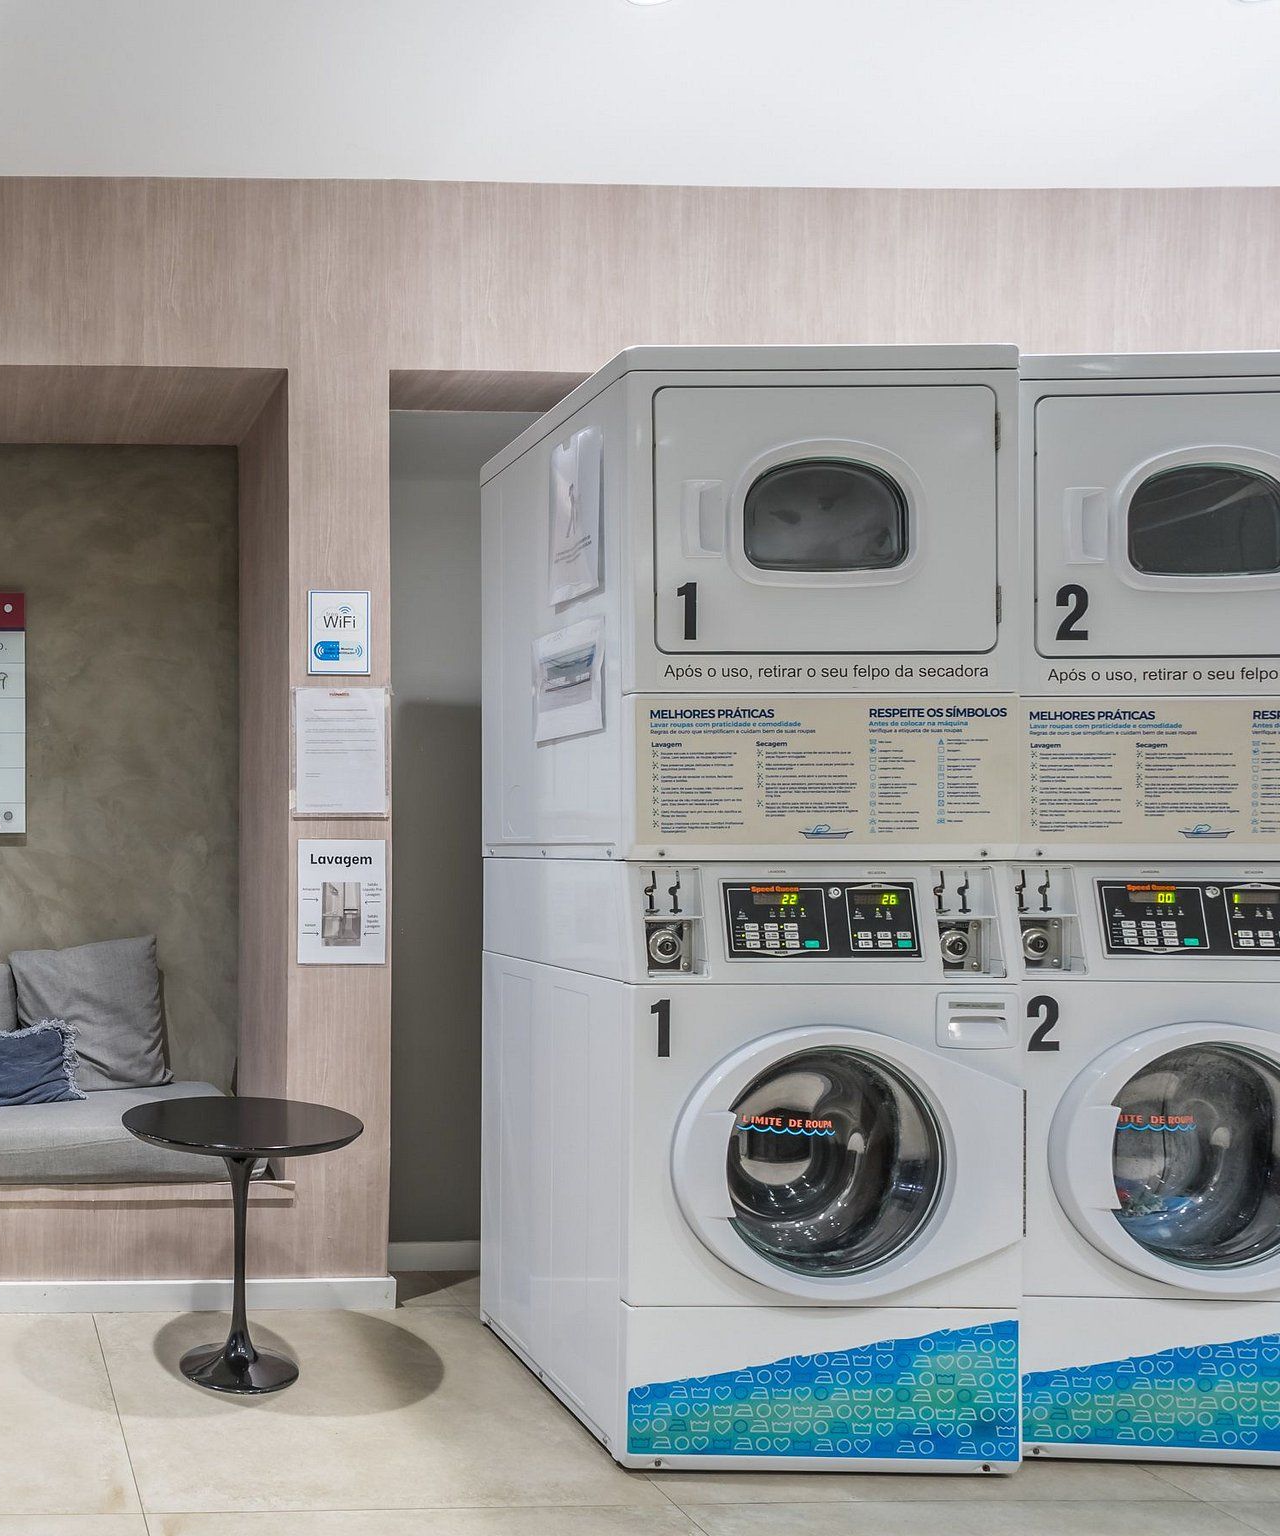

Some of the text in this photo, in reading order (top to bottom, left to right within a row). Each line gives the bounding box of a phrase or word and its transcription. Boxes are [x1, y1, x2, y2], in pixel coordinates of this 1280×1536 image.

[676, 582, 697, 640] 1
[1056, 584, 1089, 641] 2
[323, 616, 356, 628] WiFi
[664, 664, 988, 680] Após o uso, retirar o seu felpo da secadora
[1048, 667, 1278, 684] Após o uso, retirar o seu felpo
[650, 706, 775, 719] MELHORES PRÁTICAS
[869, 705, 1007, 718] RESPEITE OS SÍMBOLOS
[1029, 708, 1155, 721] MELHORES PRÁTICAS
[712, 721, 751, 729] praticidade
[310, 854, 372, 867] Lavagem
[782, 894, 797, 904] 22
[882, 894, 896, 905] 26
[650, 999, 670, 1057] 1
[1027, 995, 1059, 1051] 2
[742, 1115, 832, 1128] LIMITE DE ROUPA
[1150, 1116, 1165, 1124] DE
